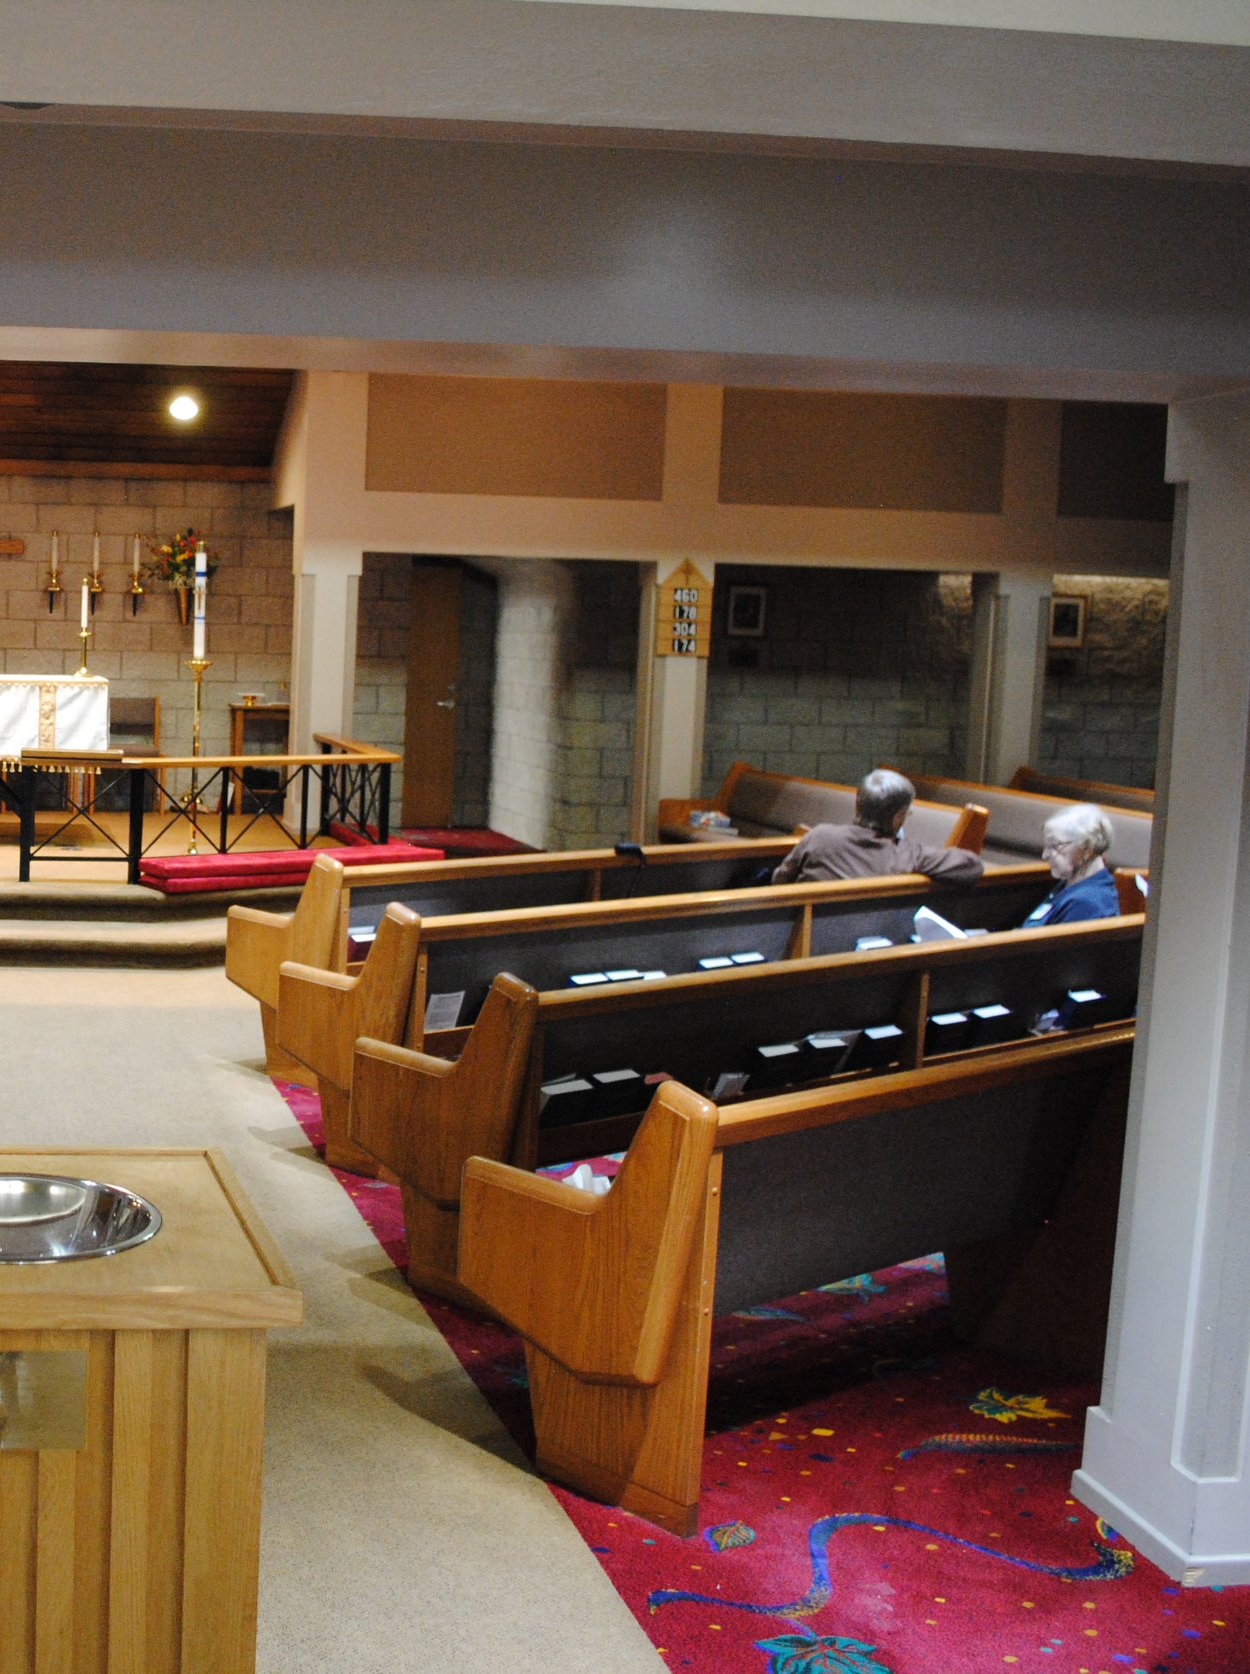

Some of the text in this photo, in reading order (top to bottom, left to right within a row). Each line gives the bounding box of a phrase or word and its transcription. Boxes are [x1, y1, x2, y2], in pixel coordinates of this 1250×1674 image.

[674, 588, 698, 603] 460
[675, 605, 697, 619] 178
[673, 622, 696, 636] 304
[674, 638, 695, 653] 174
